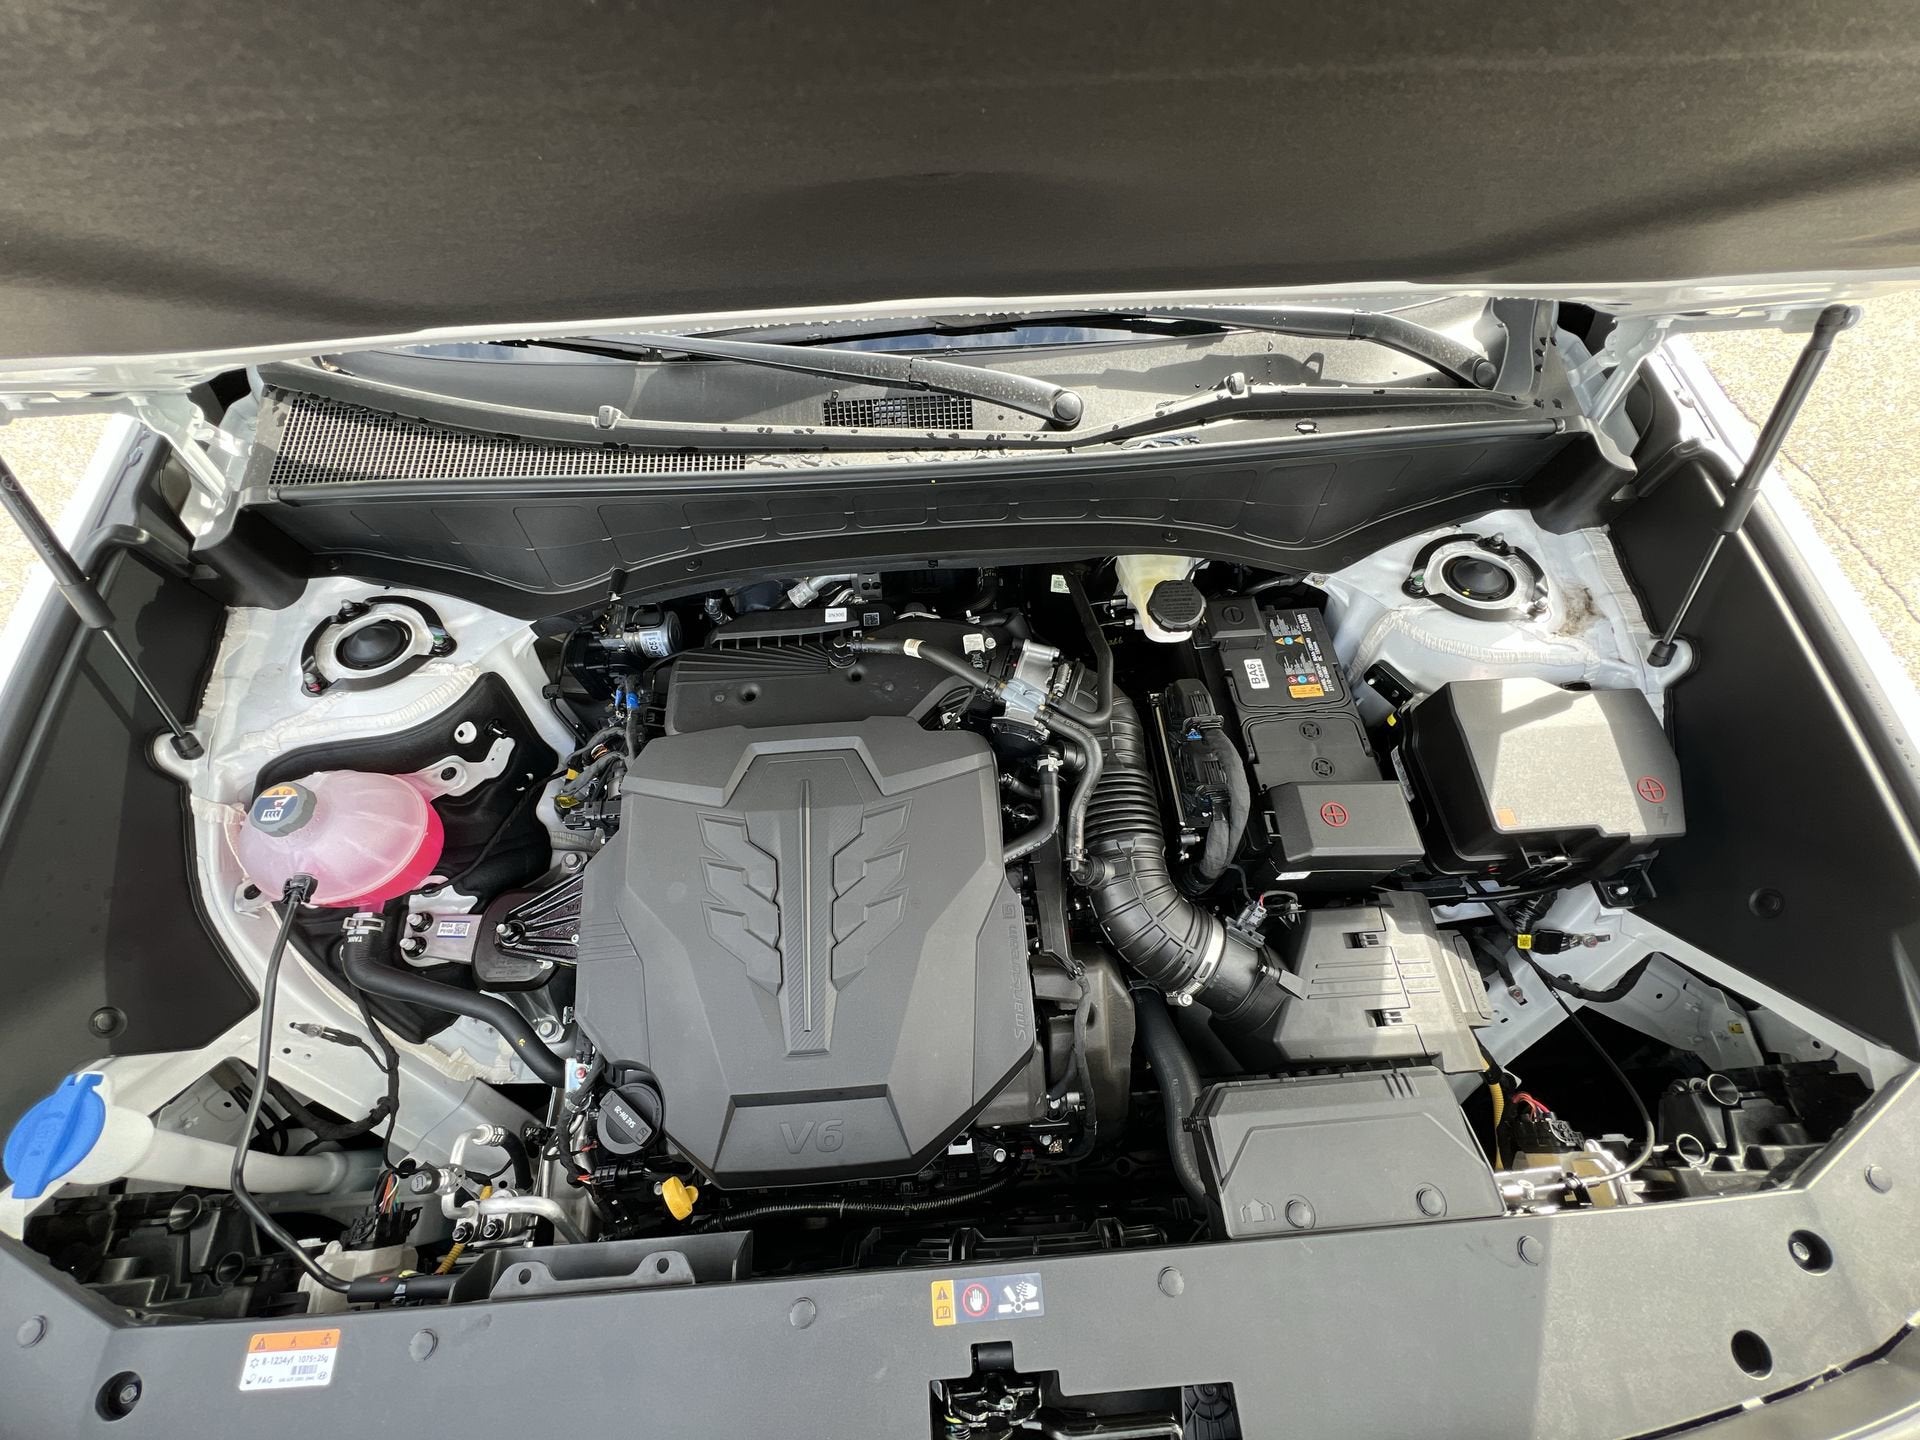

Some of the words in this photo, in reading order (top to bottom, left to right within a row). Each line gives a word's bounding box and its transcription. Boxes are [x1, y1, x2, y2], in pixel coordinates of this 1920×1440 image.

[1247, 663, 1261, 684] BA6
[1008, 925, 1027, 1041] Smartstream
[625, 1117, 636, 1129] SAE
[779, 1119, 844, 1155] V6
[257, 1376, 273, 1384] PAG
